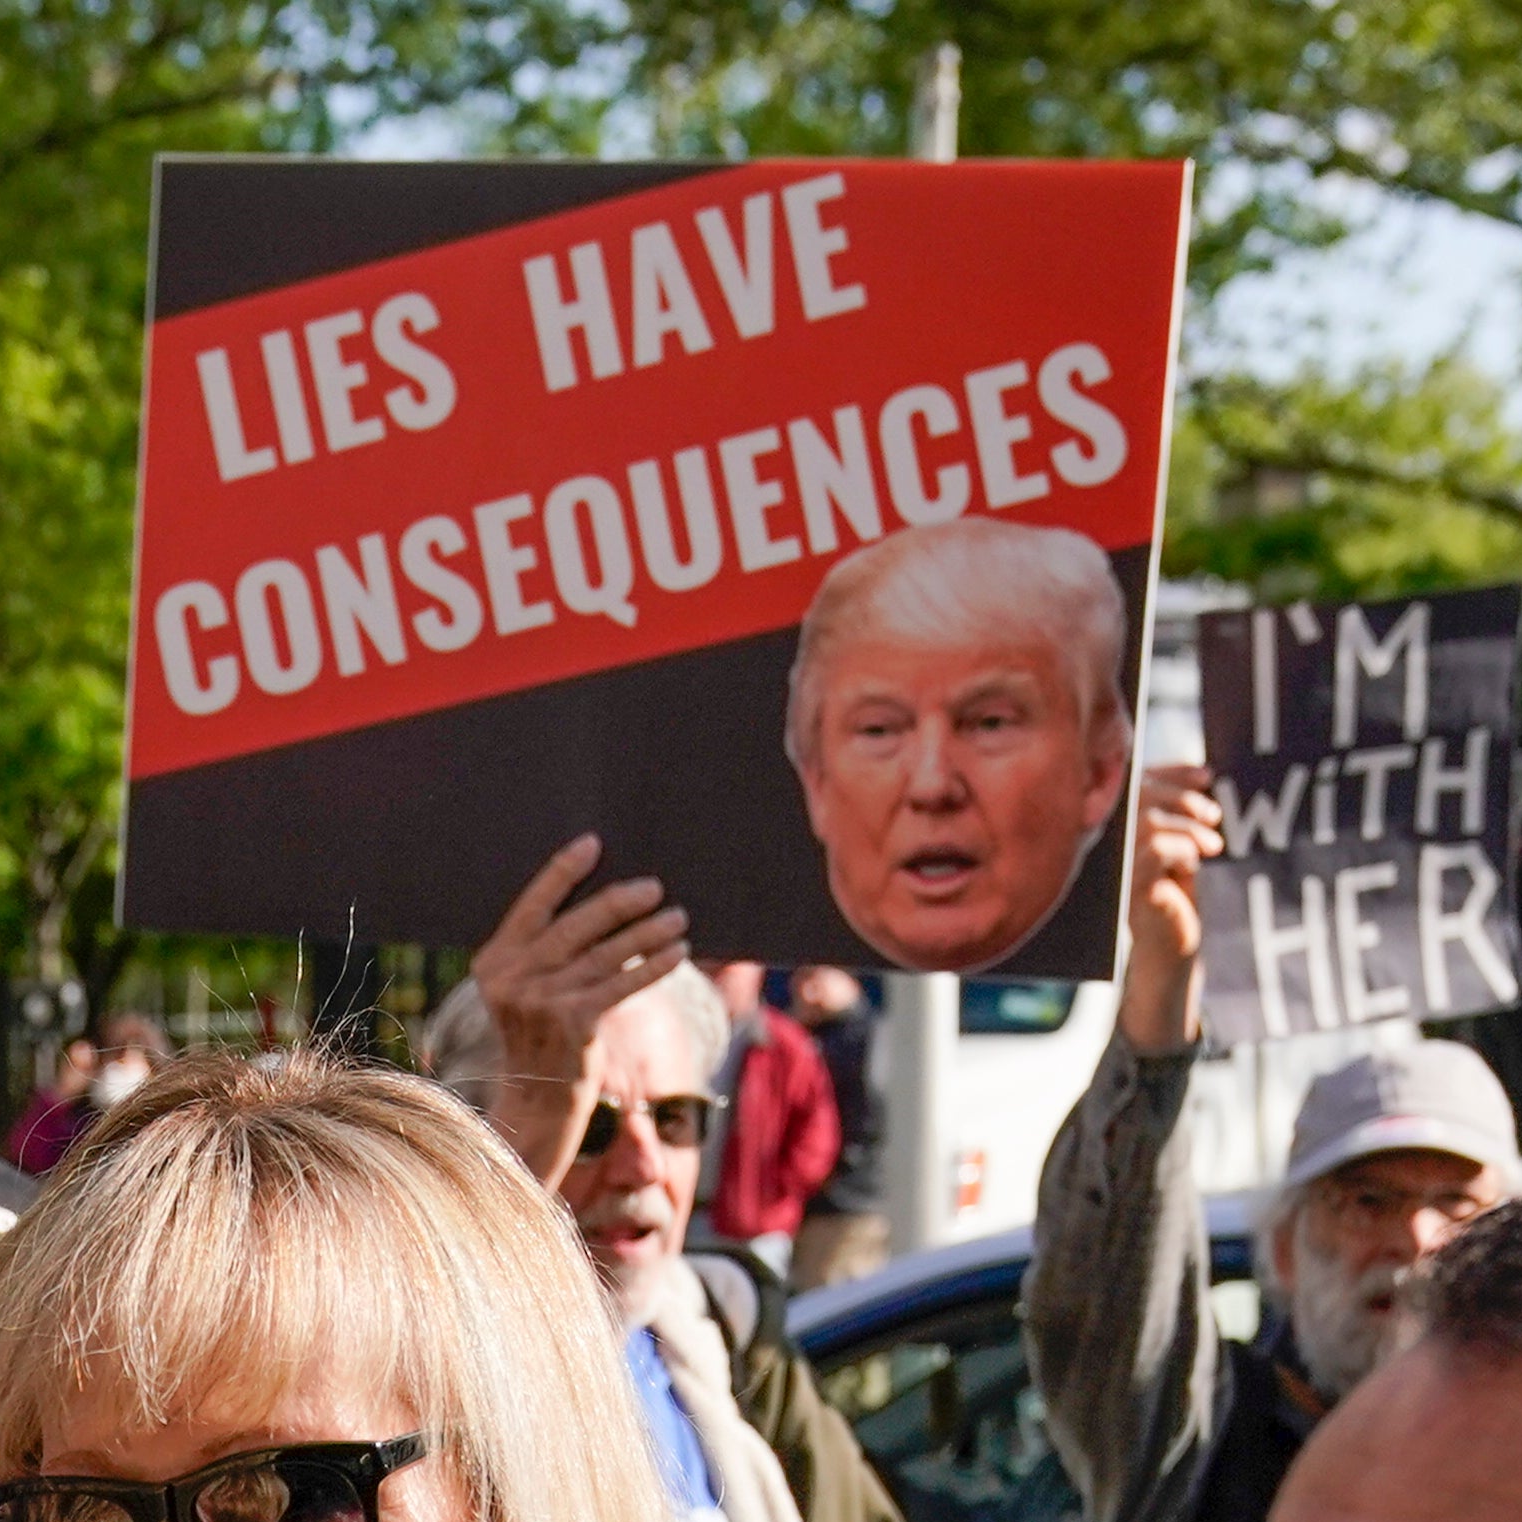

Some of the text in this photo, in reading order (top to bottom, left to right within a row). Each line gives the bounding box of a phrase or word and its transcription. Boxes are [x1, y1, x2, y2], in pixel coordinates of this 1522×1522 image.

[196, 172, 867, 484] LIES HAVE
[153, 341, 1130, 717] CONSEQUENCES
[1251, 601, 1433, 755] I'M
[1246, 843, 1521, 1039] HER
